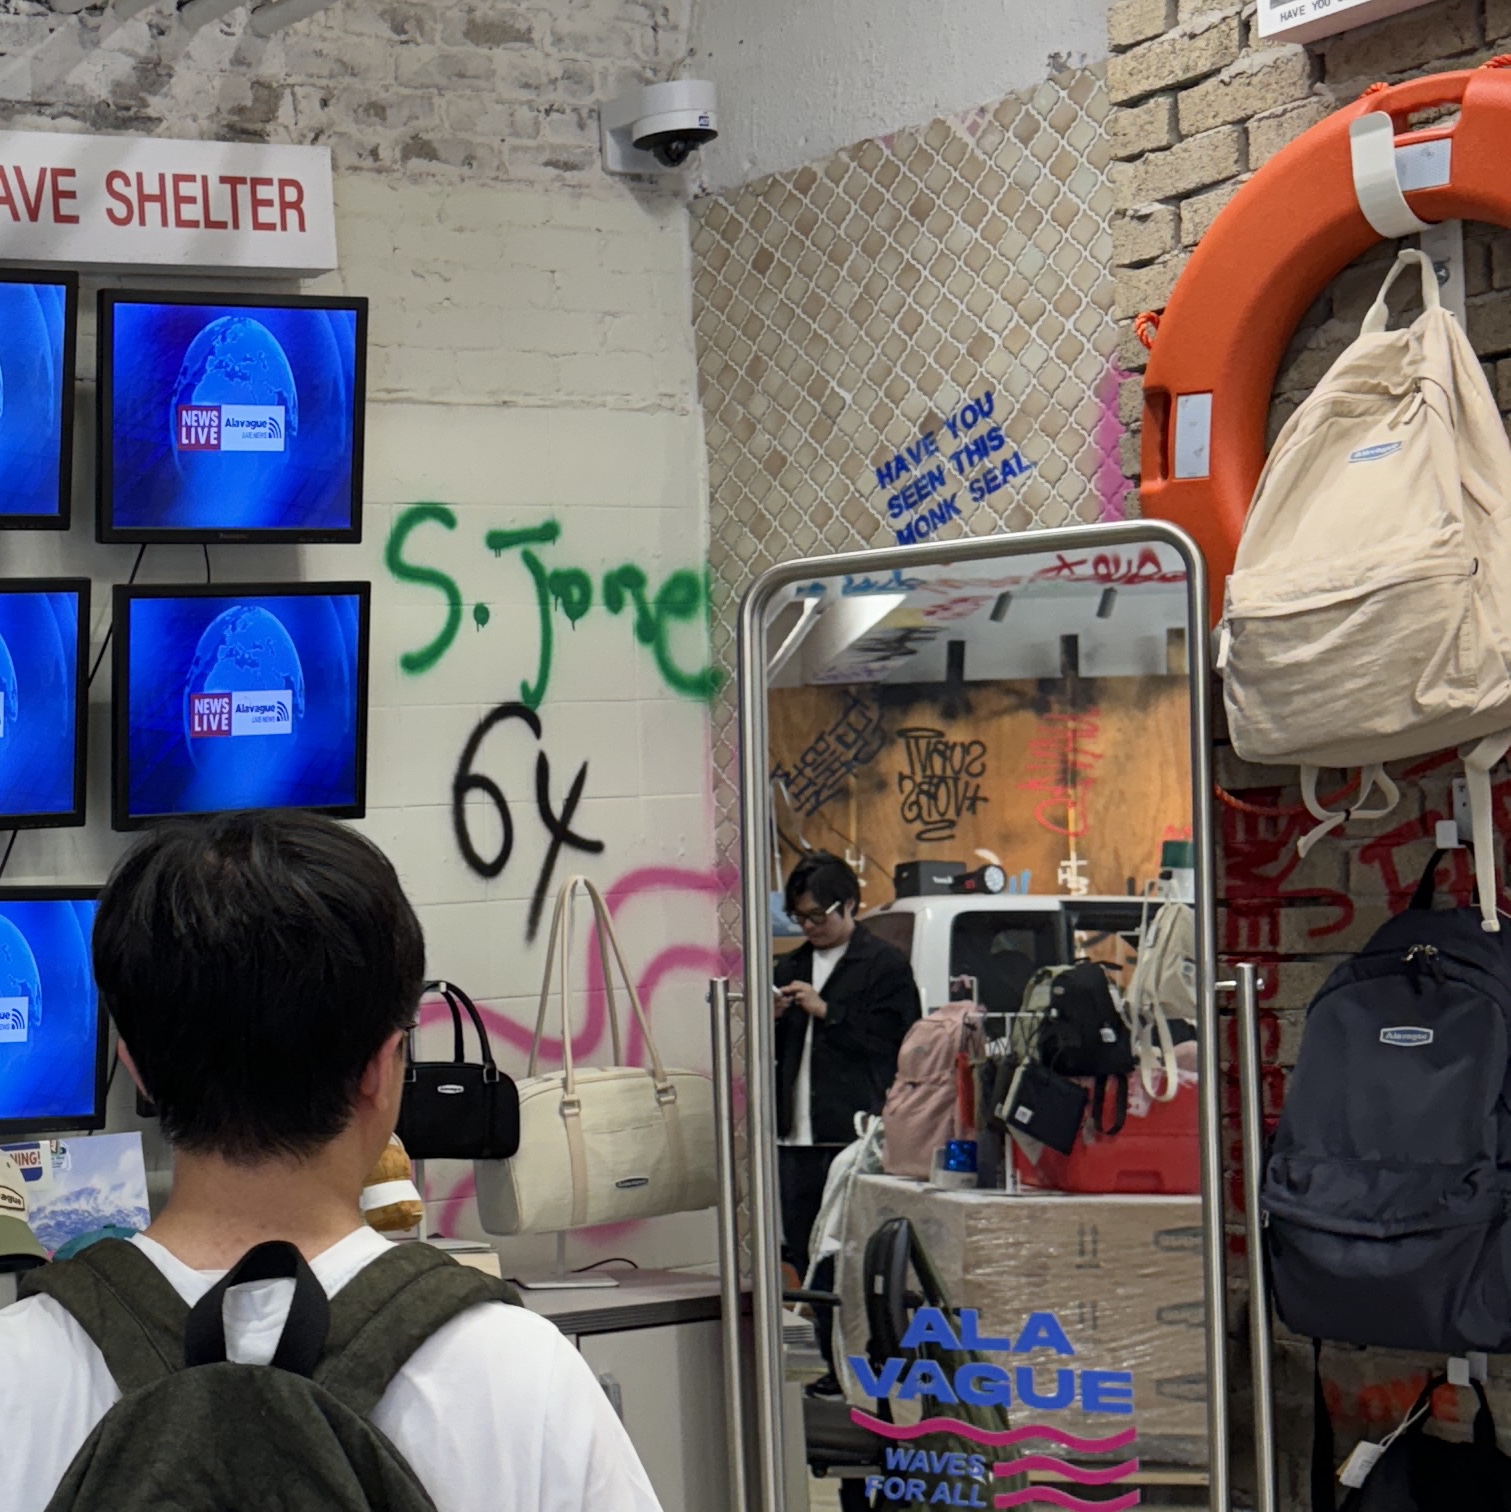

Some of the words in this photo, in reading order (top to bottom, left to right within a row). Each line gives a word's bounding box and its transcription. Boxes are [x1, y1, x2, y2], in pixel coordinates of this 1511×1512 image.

[1280, 5, 1305, 22] HAVE
[105, 169, 306, 233] SHELTER
[182, 410, 218, 427] NEWS
[225, 417, 267, 429] Alavague
[182, 427, 218, 445] LIVE
[876, 431, 939, 489] HAVE
[944, 390, 995, 439] YOU
[888, 465, 946, 518] SEEN
[949, 425, 1006, 474] THIS
[896, 492, 962, 545] MONK
[968, 451, 1034, 502] SEAL
[194, 698, 229, 714] NEWS
[236, 704, 275, 714] Alavague
[194, 714, 229, 732] LIVE
[899, 1307, 1076, 1356] ALA
[846, 1355, 1134, 1415] VAGUE
[885, 1447, 986, 1478] WAVES
[865, 1475, 926, 1502] FOR
[933, 1481, 987, 1509] ALL
